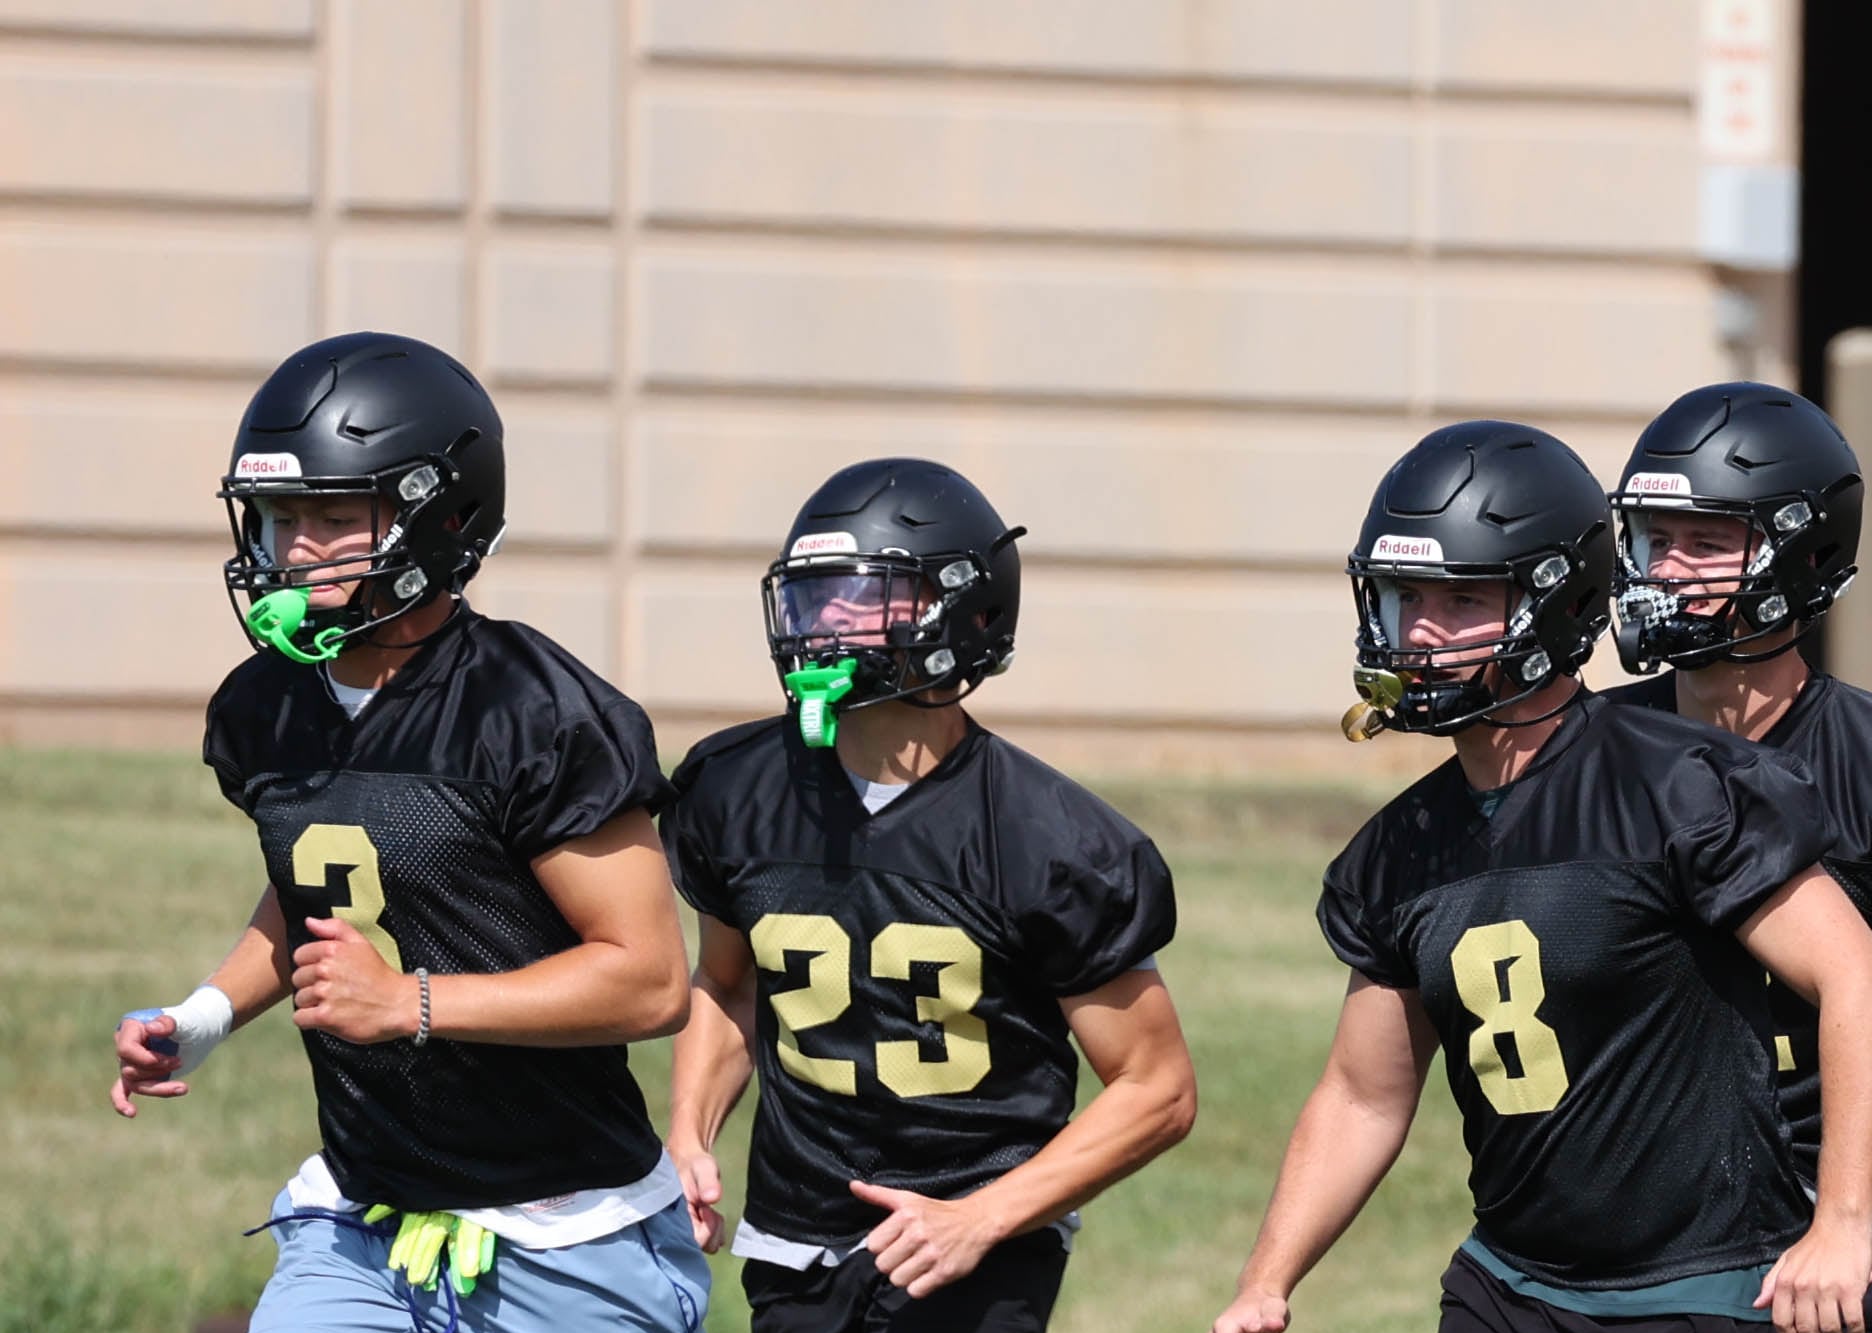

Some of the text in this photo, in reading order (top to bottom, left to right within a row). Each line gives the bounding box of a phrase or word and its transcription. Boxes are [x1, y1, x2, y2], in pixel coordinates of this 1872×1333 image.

[241, 459, 288, 473] Riddell
[1631, 476, 1680, 491] Riddell
[1378, 539, 1431, 556] Riddell
[291, 823, 404, 974] 3
[749, 913, 992, 1098] 23
[1450, 919, 1570, 1116] 8
